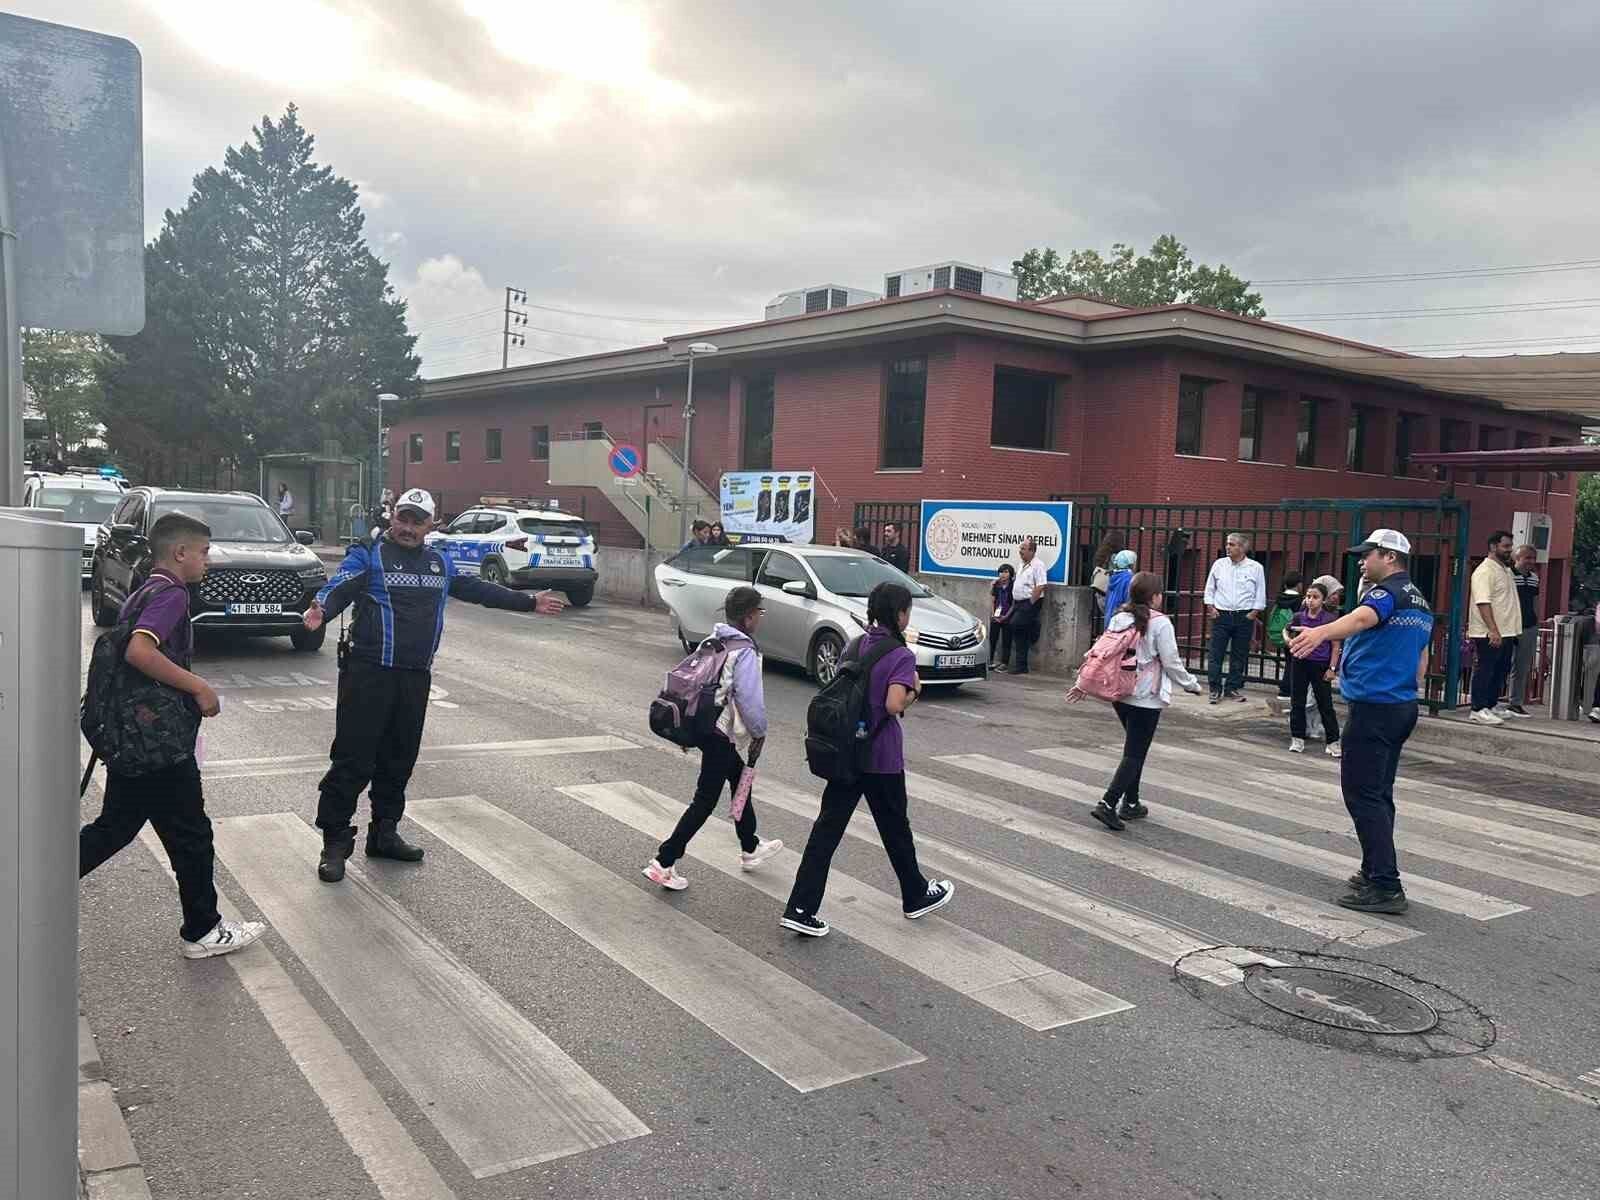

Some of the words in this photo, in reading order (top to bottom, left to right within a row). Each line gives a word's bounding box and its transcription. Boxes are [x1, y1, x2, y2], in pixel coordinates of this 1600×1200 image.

[961, 532, 996, 543] MEHMET
[960, 546, 1010, 558] ORTAOKULU
[232, 604, 241, 613] 41
[246, 604, 261, 613] BEV
[265, 604, 281, 613] 584
